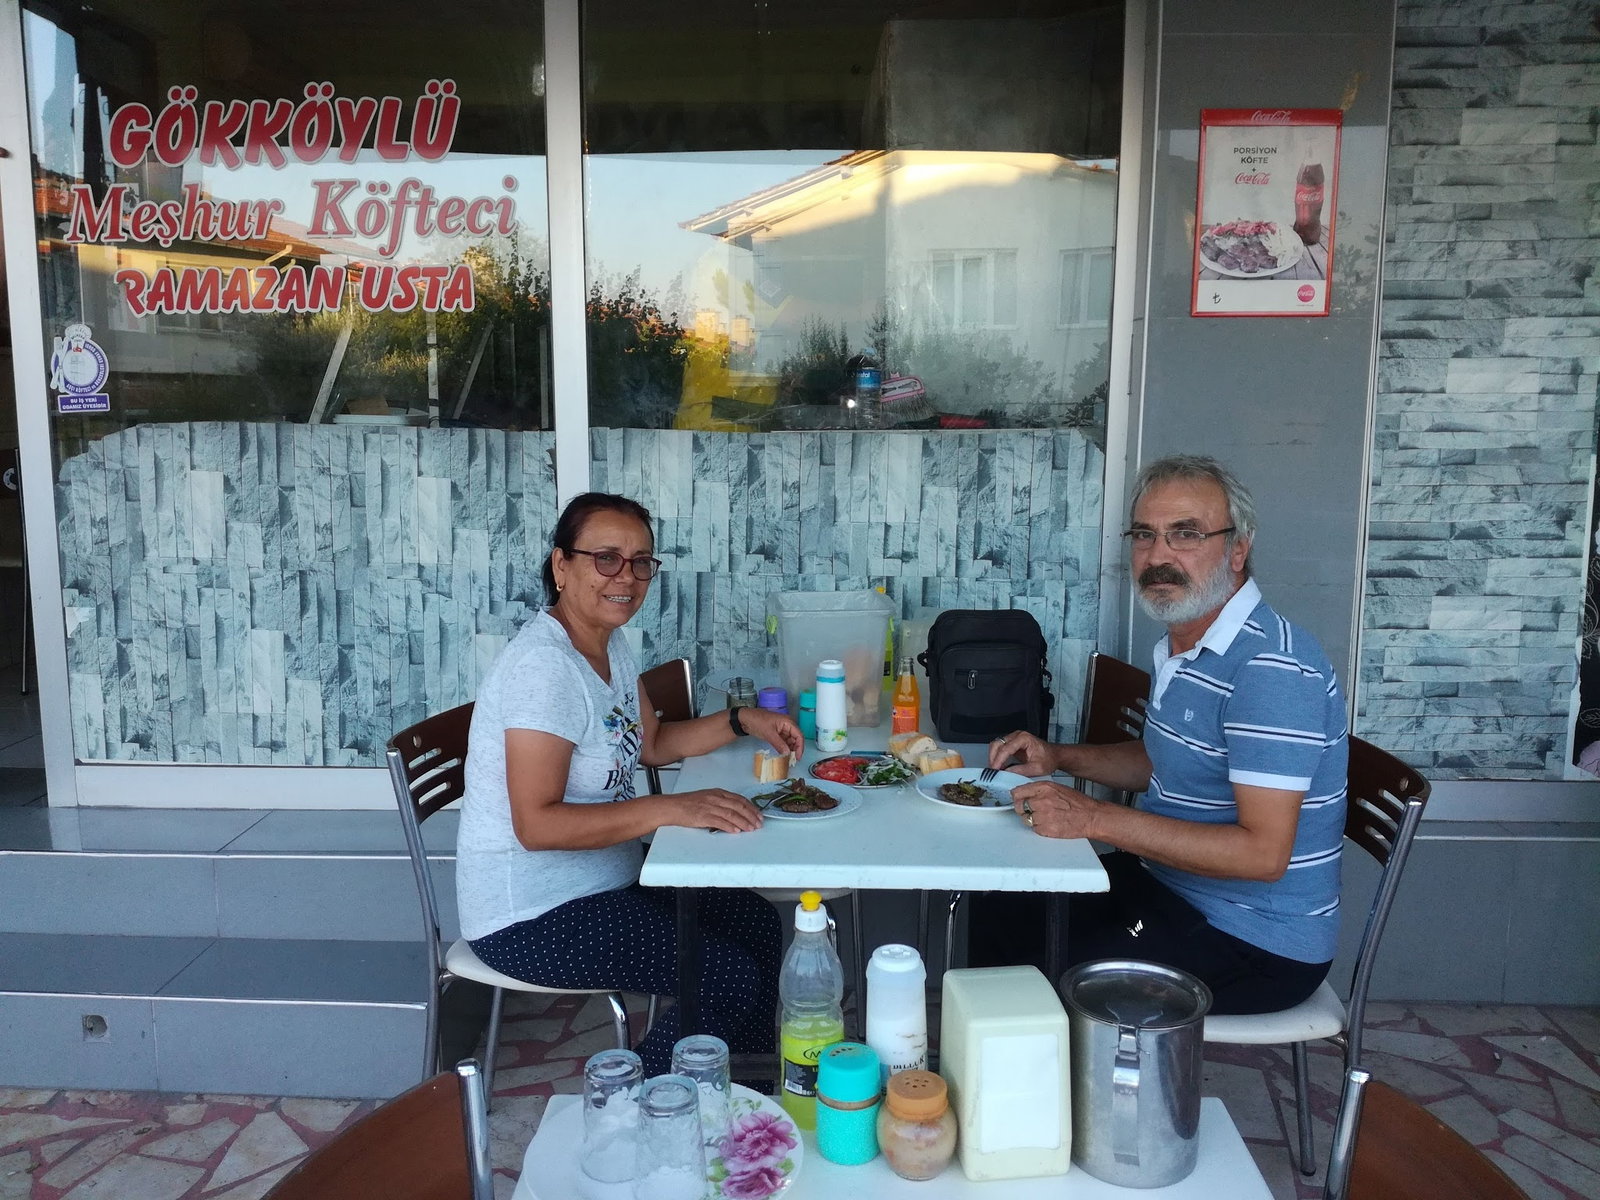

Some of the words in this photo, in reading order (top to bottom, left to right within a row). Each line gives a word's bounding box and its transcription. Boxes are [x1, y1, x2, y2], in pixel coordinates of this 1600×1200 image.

[109, 79, 461, 171] GÖKKÖYLÜ
[1233, 146, 1277, 155] PORSİYON
[1240, 156, 1269, 164] KÖFTE
[64, 181, 284, 247] Meşhur
[304, 175, 518, 259] Köfteci
[114, 264, 346, 318] RAMAZAN
[359, 264, 476, 313] USTA
